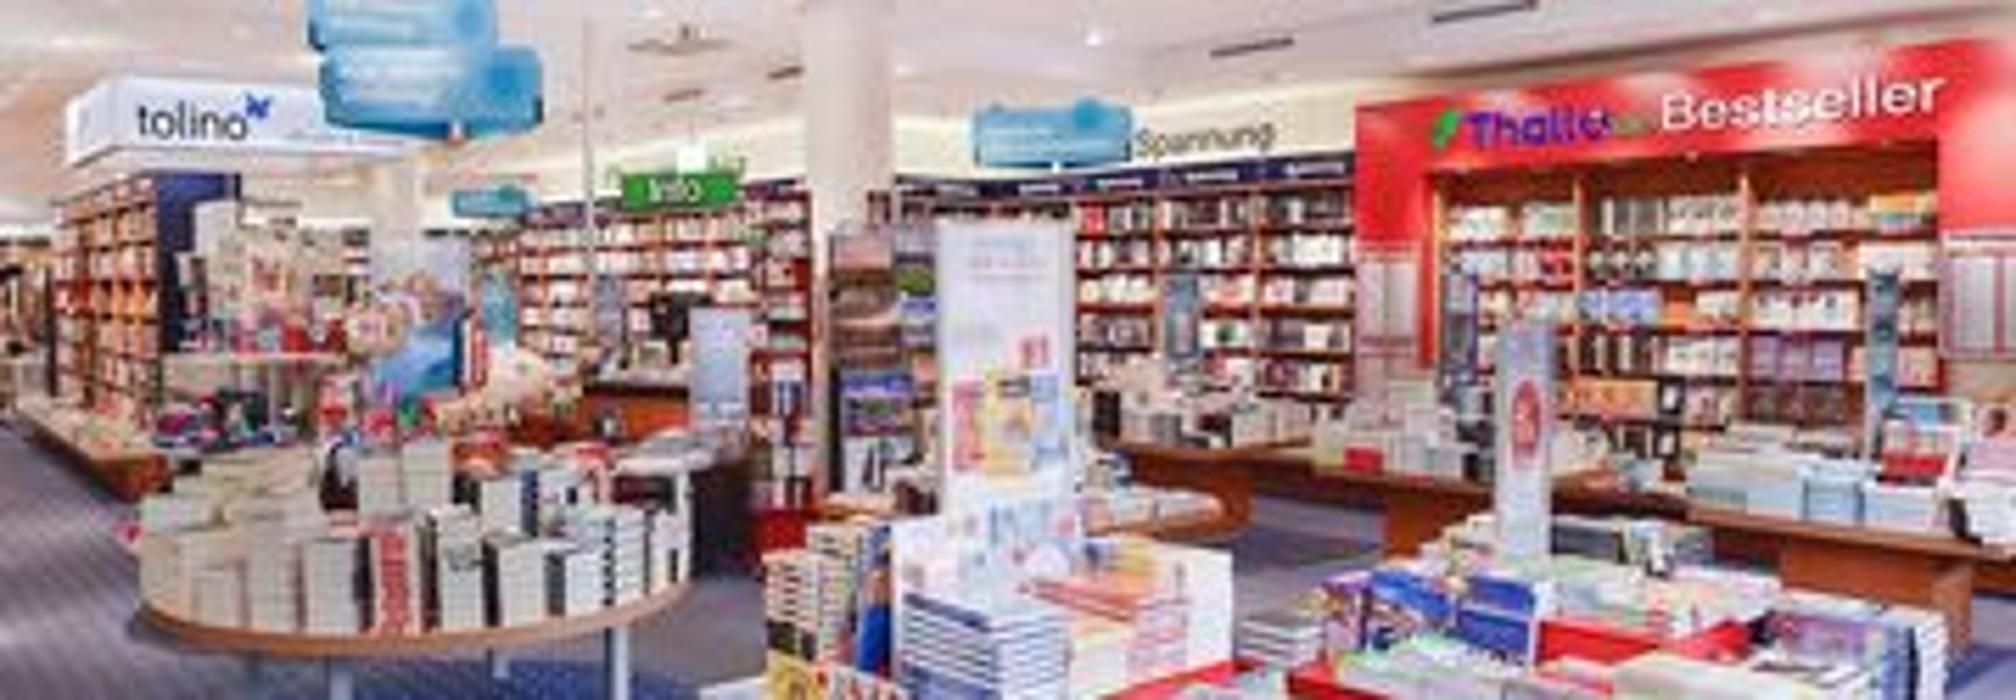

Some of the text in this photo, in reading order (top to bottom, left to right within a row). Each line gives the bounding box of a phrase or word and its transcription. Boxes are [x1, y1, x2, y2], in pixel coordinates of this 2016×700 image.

[137, 99, 249, 141] tolino
[1660, 73, 1945, 131] Bestseller
[1136, 121, 1276, 161] Spannung
[648, 177, 703, 203] Info
